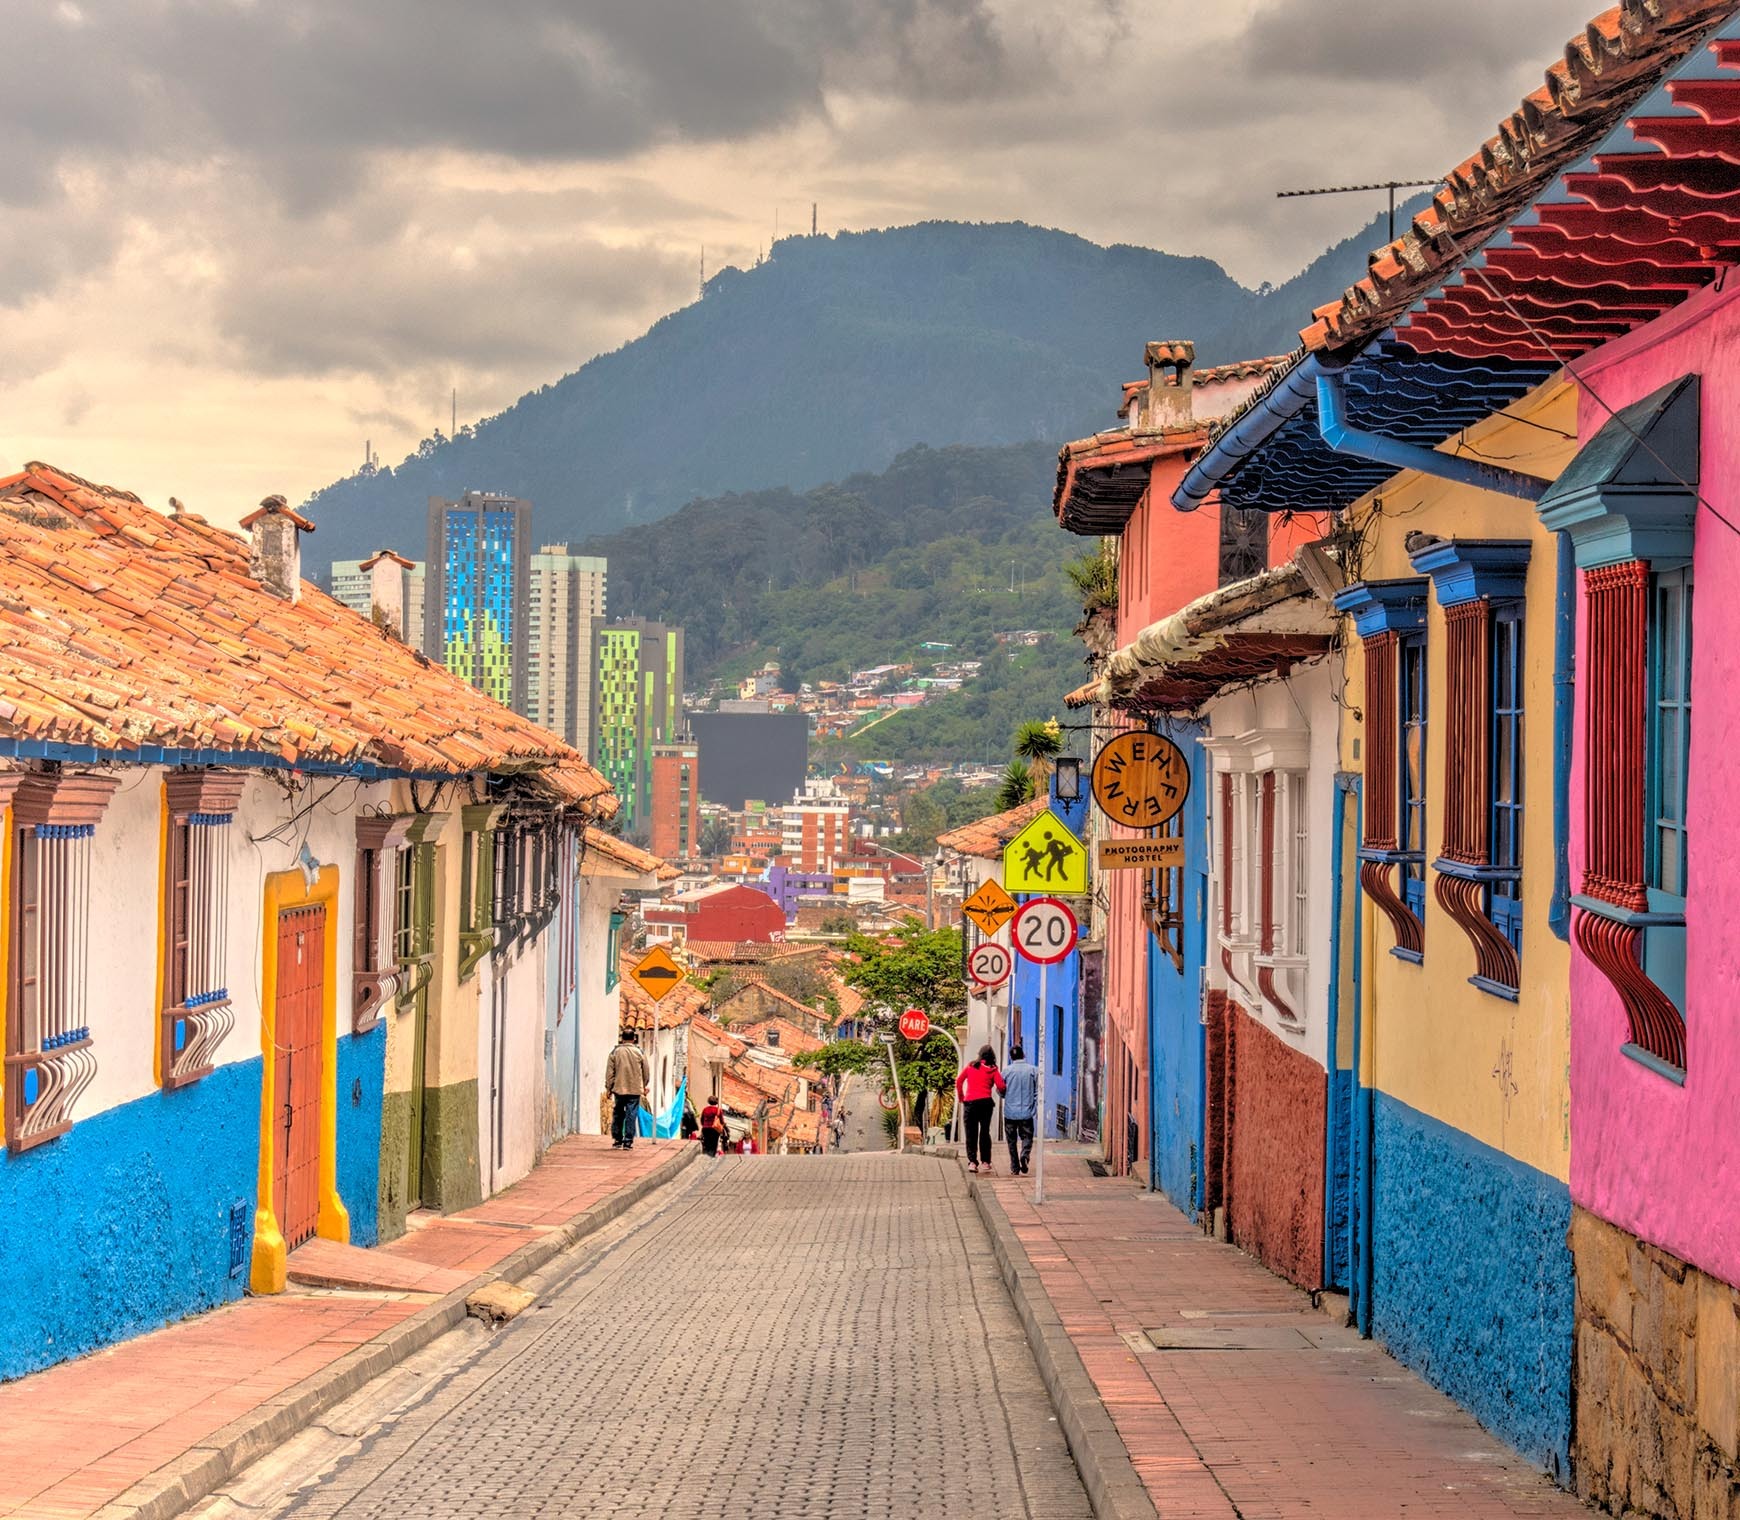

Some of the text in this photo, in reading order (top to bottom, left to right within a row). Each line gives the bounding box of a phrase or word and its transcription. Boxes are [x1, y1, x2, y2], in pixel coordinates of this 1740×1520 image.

[1105, 844, 1179, 855] PHOTOGRAPHY
[1124, 854, 1163, 863] HOSTEL
[1024, 915, 1065, 947] 20
[976, 954, 1003, 974] 20
[901, 1017, 927, 1031] PARE
